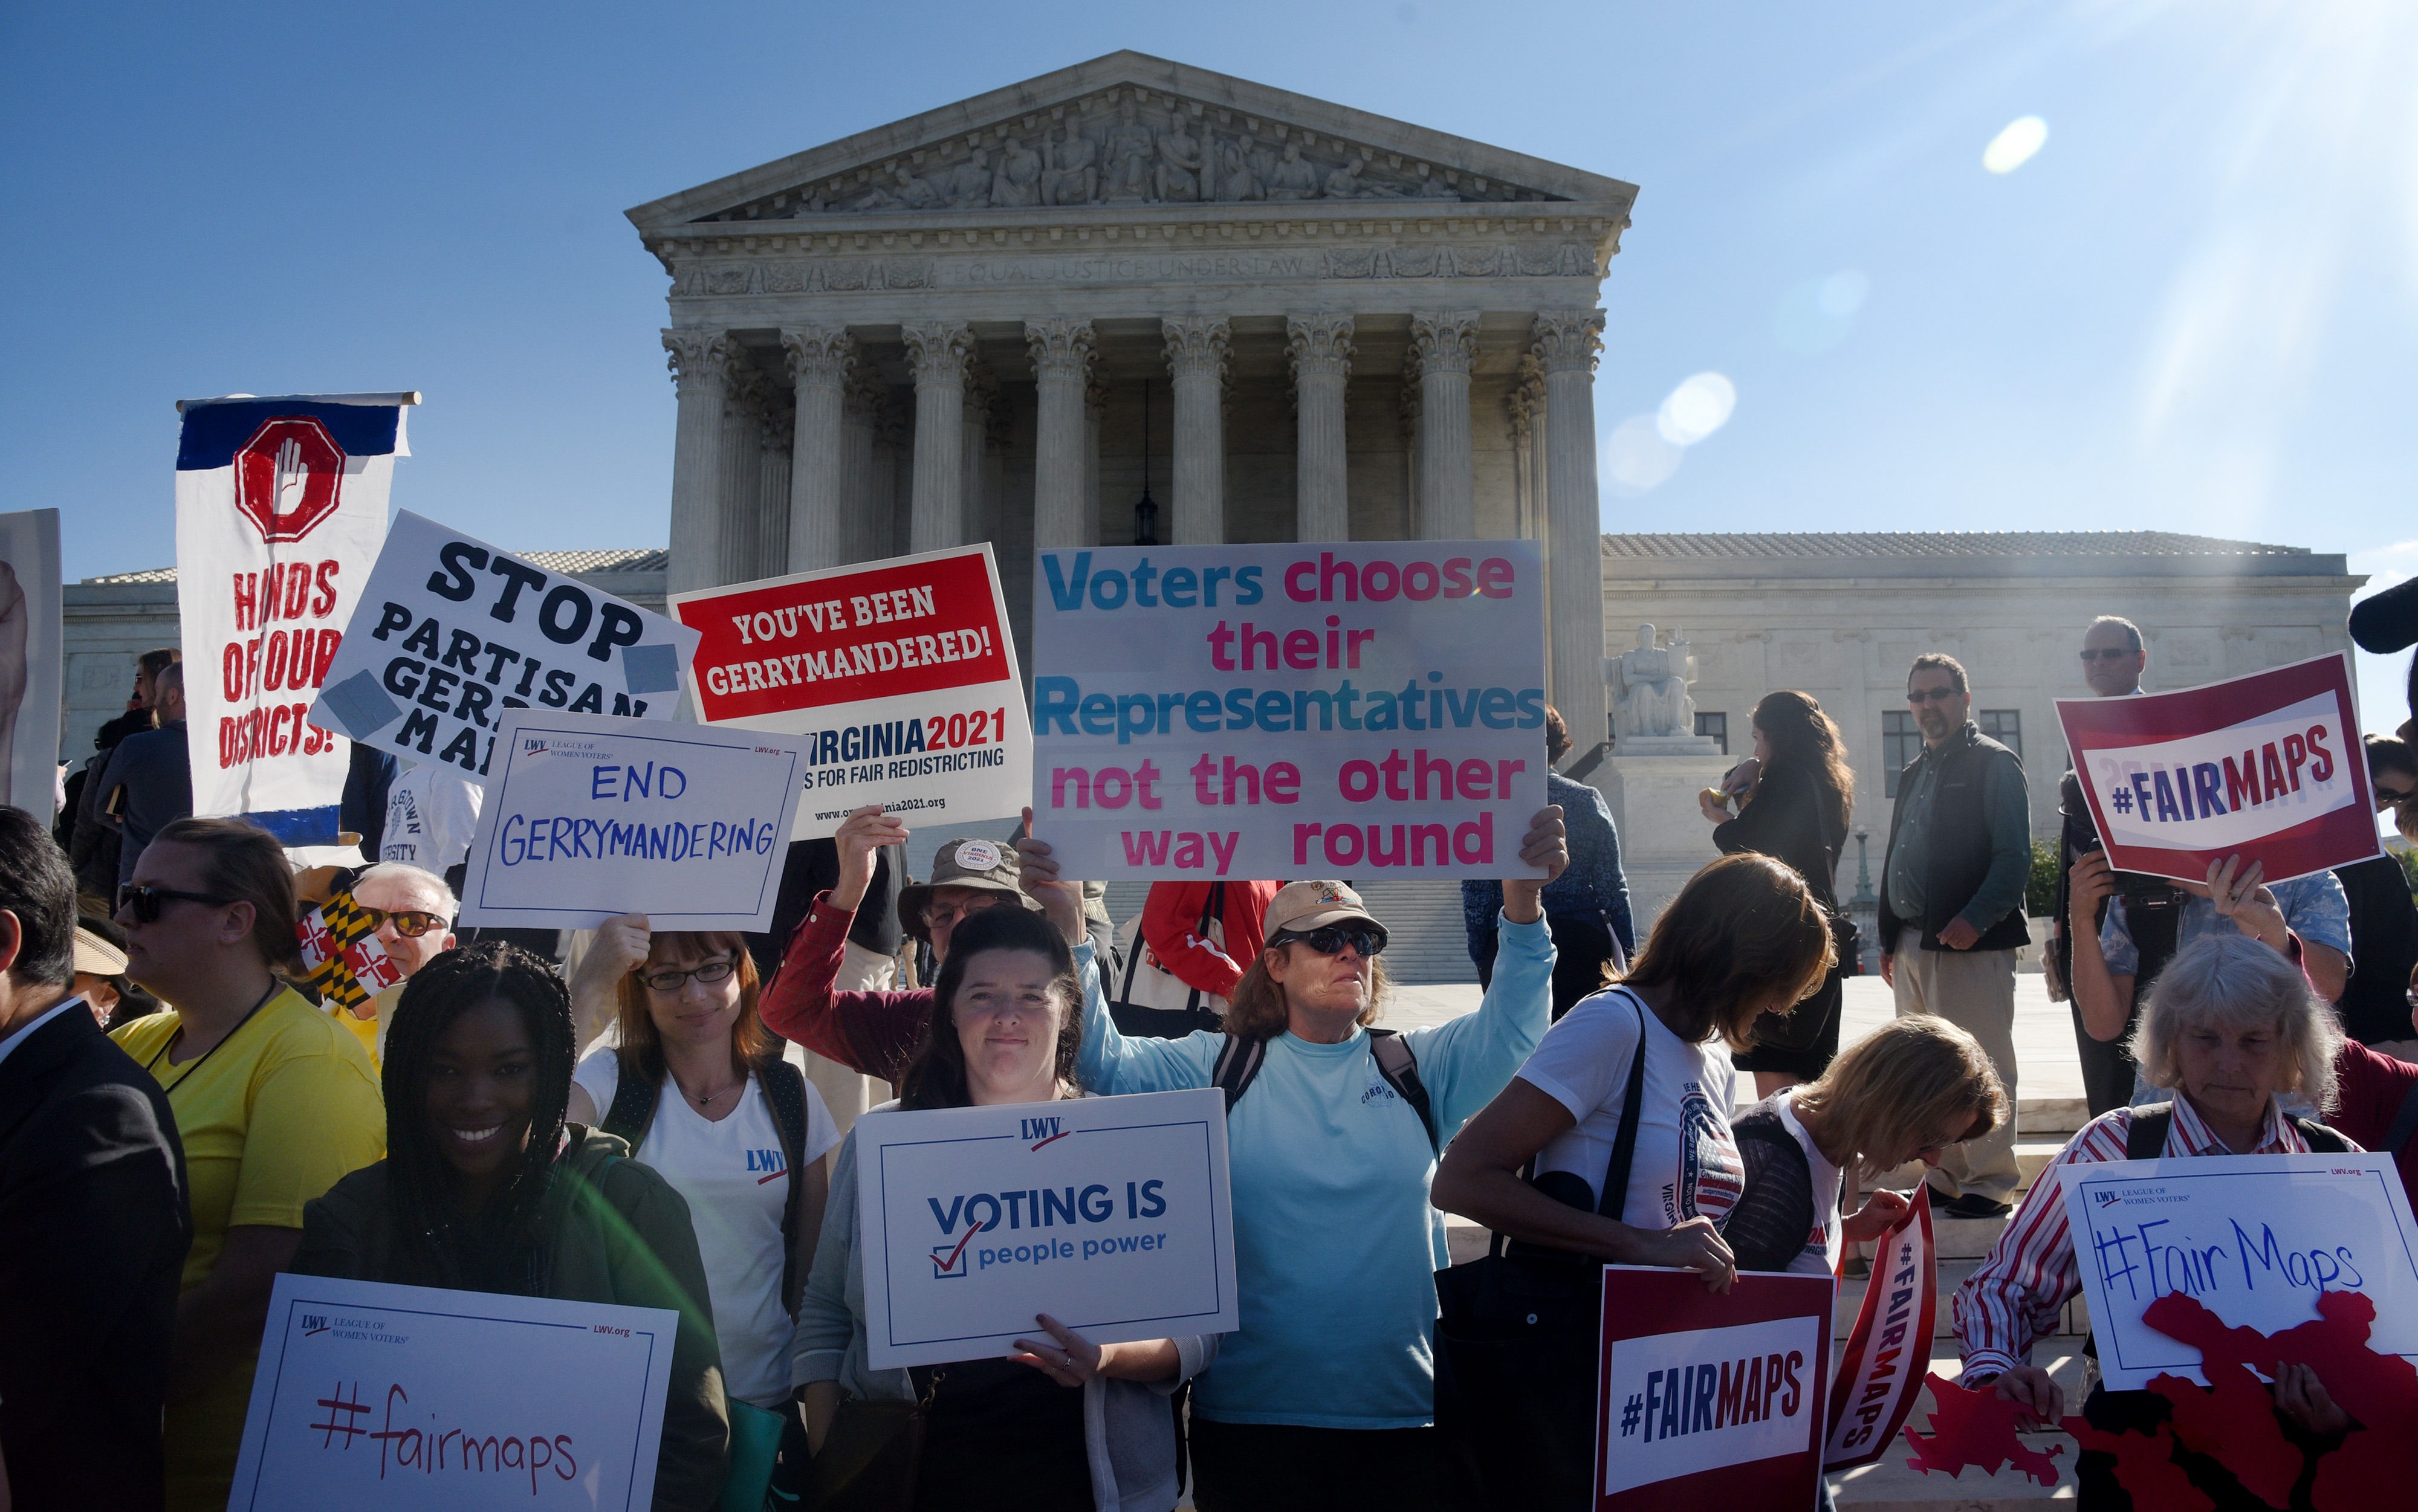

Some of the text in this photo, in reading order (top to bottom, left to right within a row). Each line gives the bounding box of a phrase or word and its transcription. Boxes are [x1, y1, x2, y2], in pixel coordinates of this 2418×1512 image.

[954, 257, 1303, 282] EQUAL JUSTICE UNDER LAW
[427, 541, 643, 662] STOP
[1042, 551, 1514, 612] Voters choose
[733, 585, 936, 645] YOU'VE BEEN
[372, 602, 648, 718] PARTISAN
[707, 626, 993, 696] GERRYMANDERED!
[1207, 615, 1375, 671] their
[1034, 671, 1545, 745] Representatives
[524, 740, 547, 750] LWV
[754, 746, 780, 756] LWV.org
[802, 707, 1005, 766] IRGINIA2021
[592, 761, 686, 801] END
[818, 769, 845, 787] FOR
[851, 764, 883, 783] FAIR
[889, 748, 1003, 780] REDISTRICTING
[1051, 749, 1525, 810] not the other
[2113, 725, 2334, 822] #FAIRMAPS
[501, 813, 773, 867] GERRYMANDERING
[964, 851, 993, 860] VIRGINIA
[1121, 812, 1493, 876] way round
[1021, 1117, 1061, 1140] LWV
[746, 1149, 783, 1172] LWV
[2331, 1167, 2361, 1176] LWV.org
[927, 1179, 1167, 1235] VOTING IS
[1662, 1183, 1678, 1225] VIRGIN
[2094, 1191, 2115, 1202] LWV
[2122, 1188, 2154, 1197] LEAGUE
[979, 1232, 1167, 1269] people power
[302, 1314, 328, 1329] LWV
[332, 1330, 368, 1340] WOMEN
[334, 1318, 386, 1330] LEAGUE OF
[593, 1325, 630, 1337] LWV.org
[1843, 1242, 1915, 1449] #FAIRMAPS
[1621, 1350, 1803, 1443] #FAIRMAPS
[310, 1380, 577, 1497] #fairmaps
